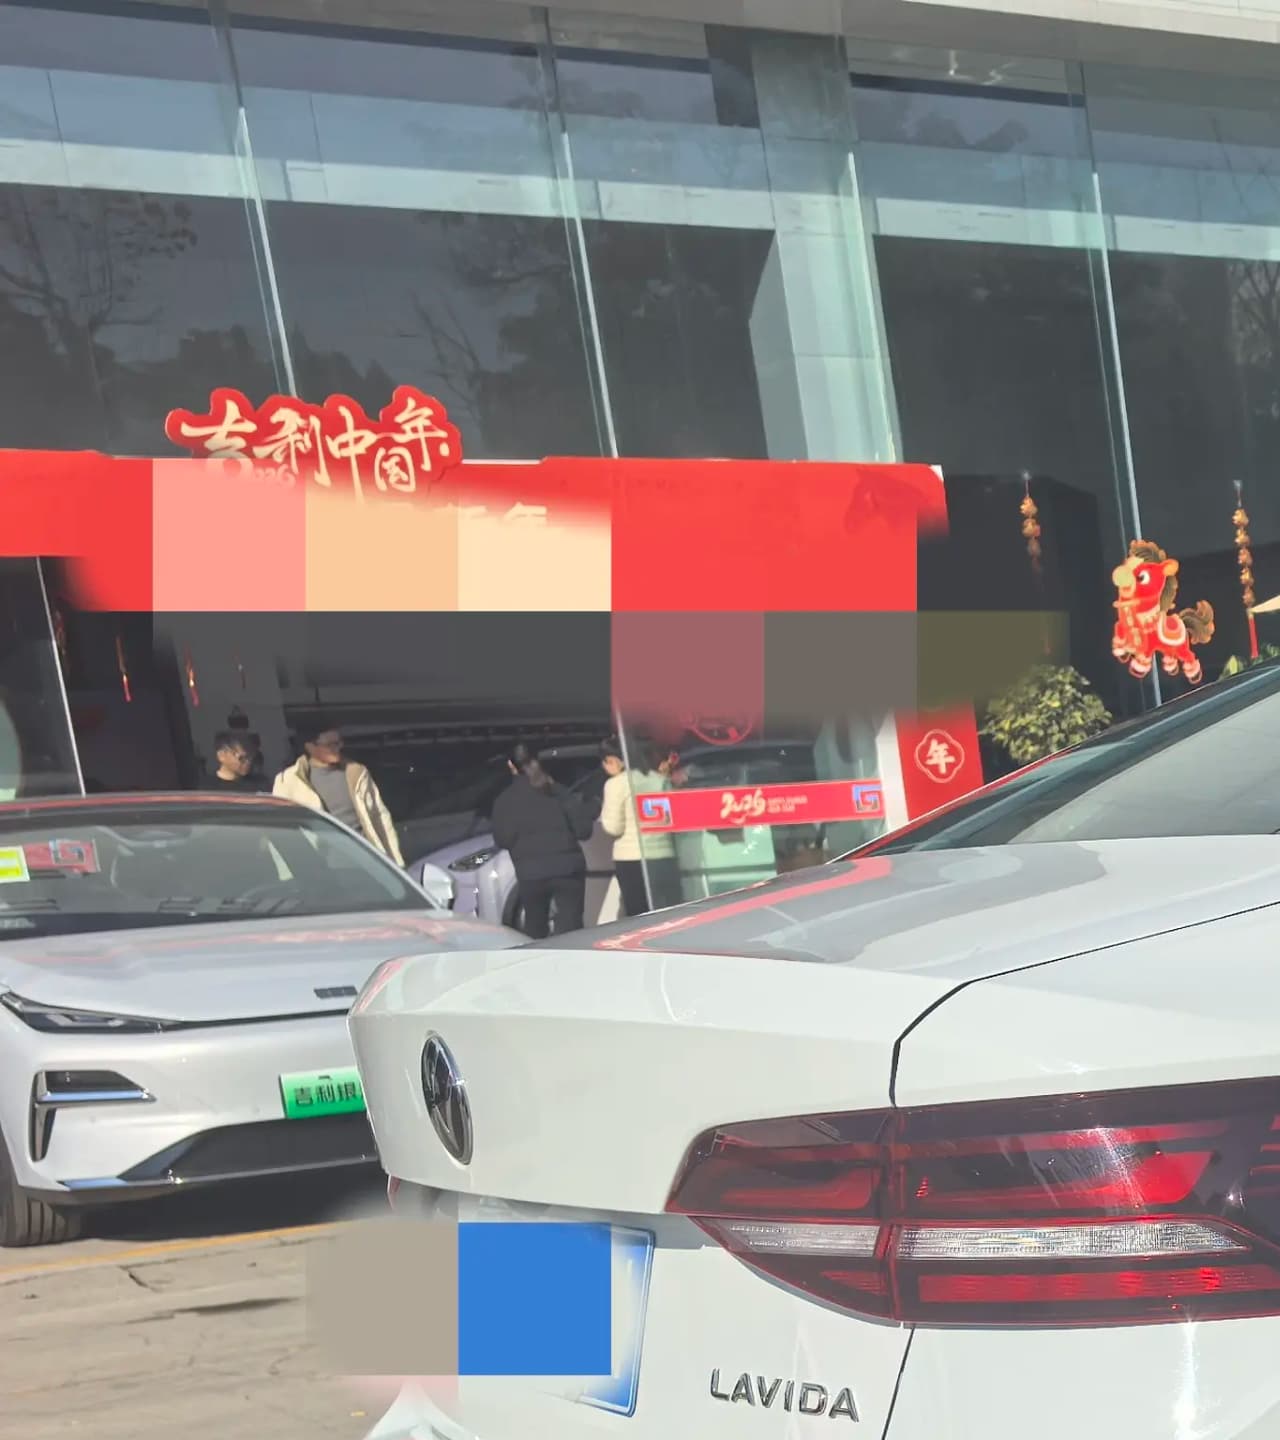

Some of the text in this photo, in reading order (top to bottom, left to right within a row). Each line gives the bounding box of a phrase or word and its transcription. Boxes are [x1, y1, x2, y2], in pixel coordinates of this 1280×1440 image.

[925, 737, 956, 774] 年
[293, 1081, 363, 1106] 吉利银
[710, 1368, 860, 1423] LAVIDA
